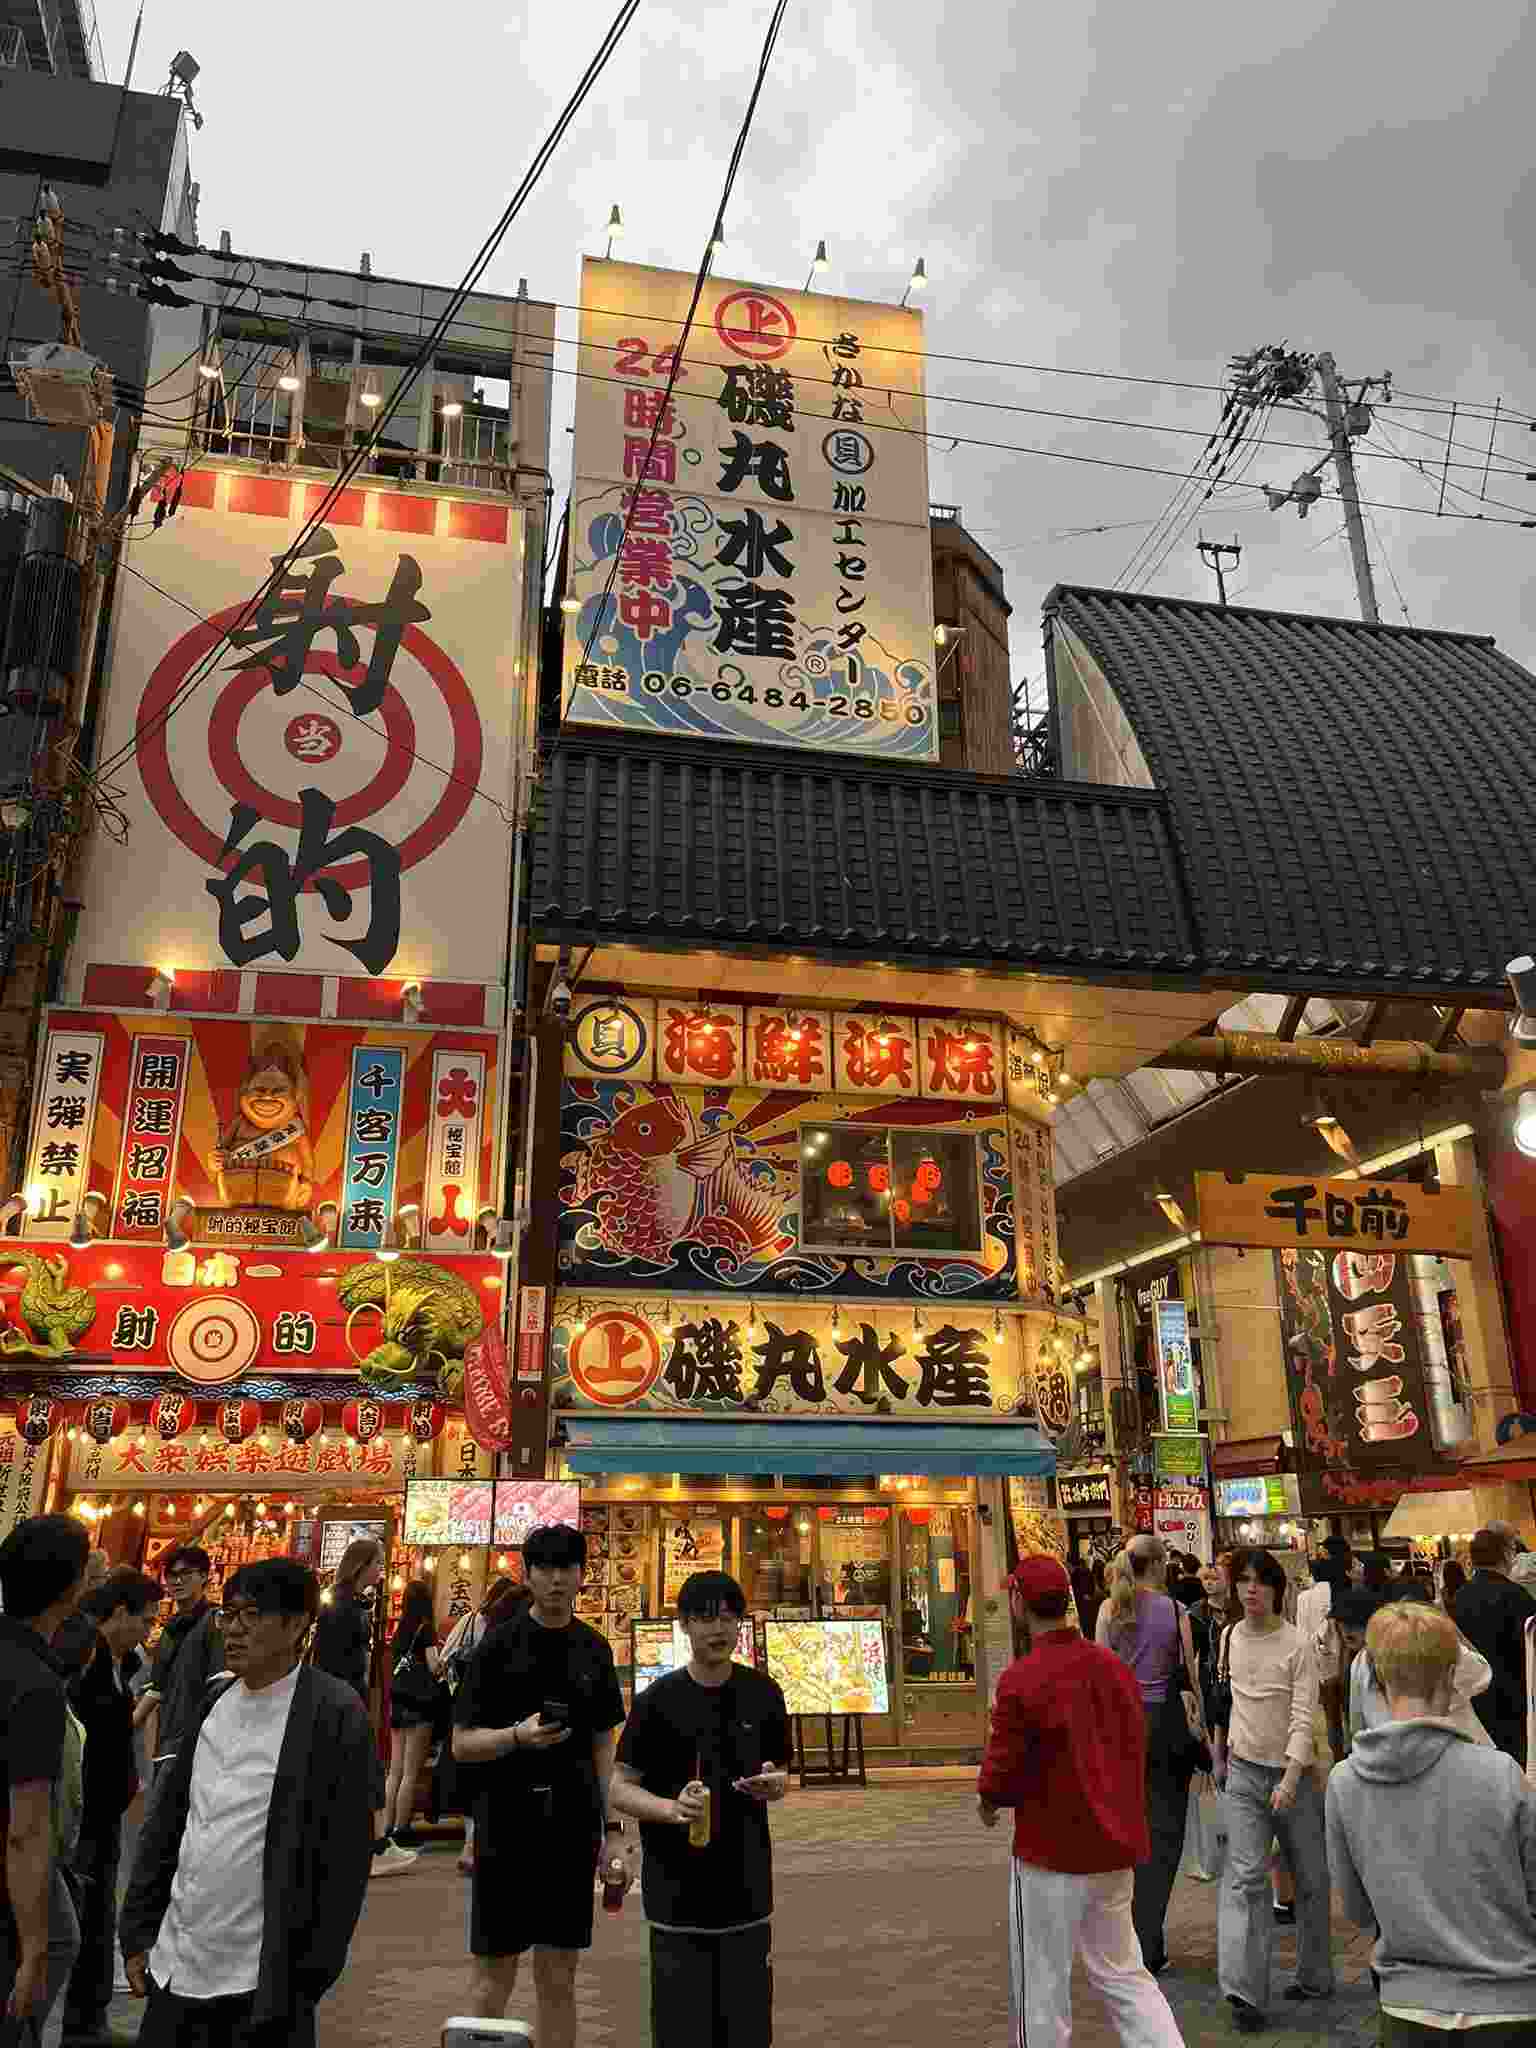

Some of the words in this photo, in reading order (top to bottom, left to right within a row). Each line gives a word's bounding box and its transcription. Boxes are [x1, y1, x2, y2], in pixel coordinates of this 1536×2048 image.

[714, 364, 796, 661] 磯丸水産
[643, 673, 926, 725] 06-6484-2850
[31, 1051, 92, 1226] 実弾禁止
[123, 1053, 179, 1229] 開運招福
[347, 1065, 396, 1233] 千客万来
[1264, 1184, 1410, 1238] 千日前
[664, 1318, 993, 1407] 磯丸水産
